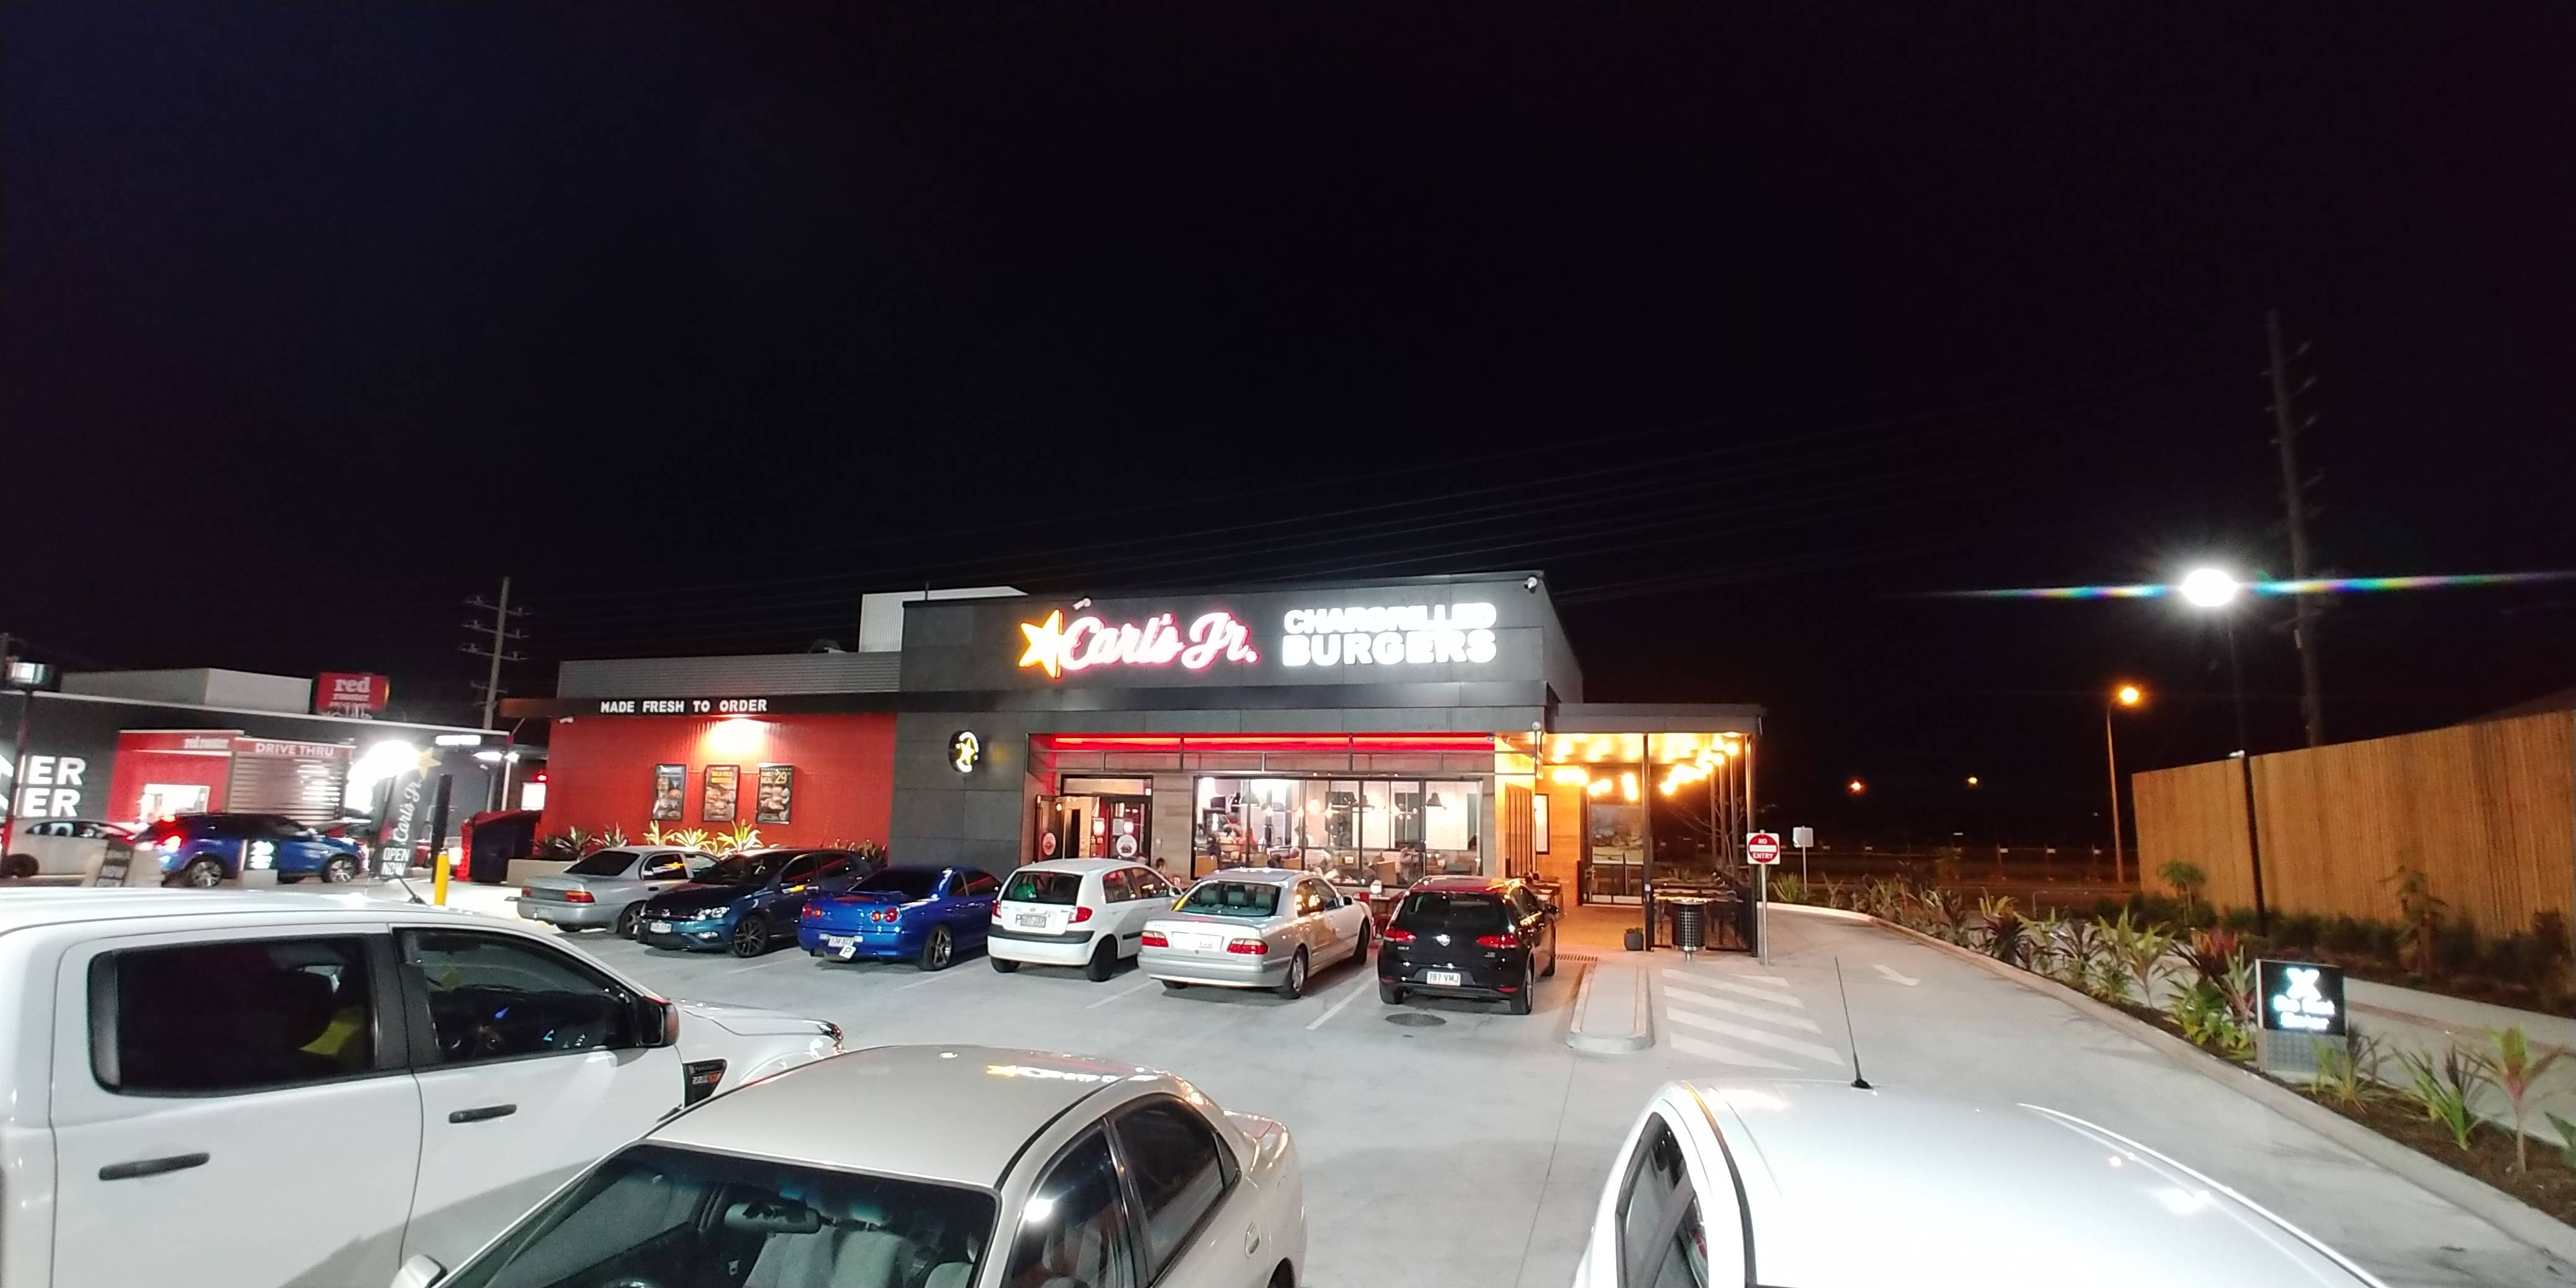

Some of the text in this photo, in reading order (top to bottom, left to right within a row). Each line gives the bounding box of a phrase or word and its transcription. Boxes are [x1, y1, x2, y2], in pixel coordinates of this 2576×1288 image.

[1060, 611, 1258, 671] Carl's Jr.
[1282, 629, 1497, 666] BURGERS
[334, 677, 370, 693] red
[601, 699, 767, 713] MADE FRESH TO ORDER
[256, 743, 334, 756] DRIVE THRU
[393, 803, 415, 843] Carl's
[383, 847, 410, 861] OPEN
[381, 862, 406, 876] NOW
[1443, 974, 1460, 983] VMJ
